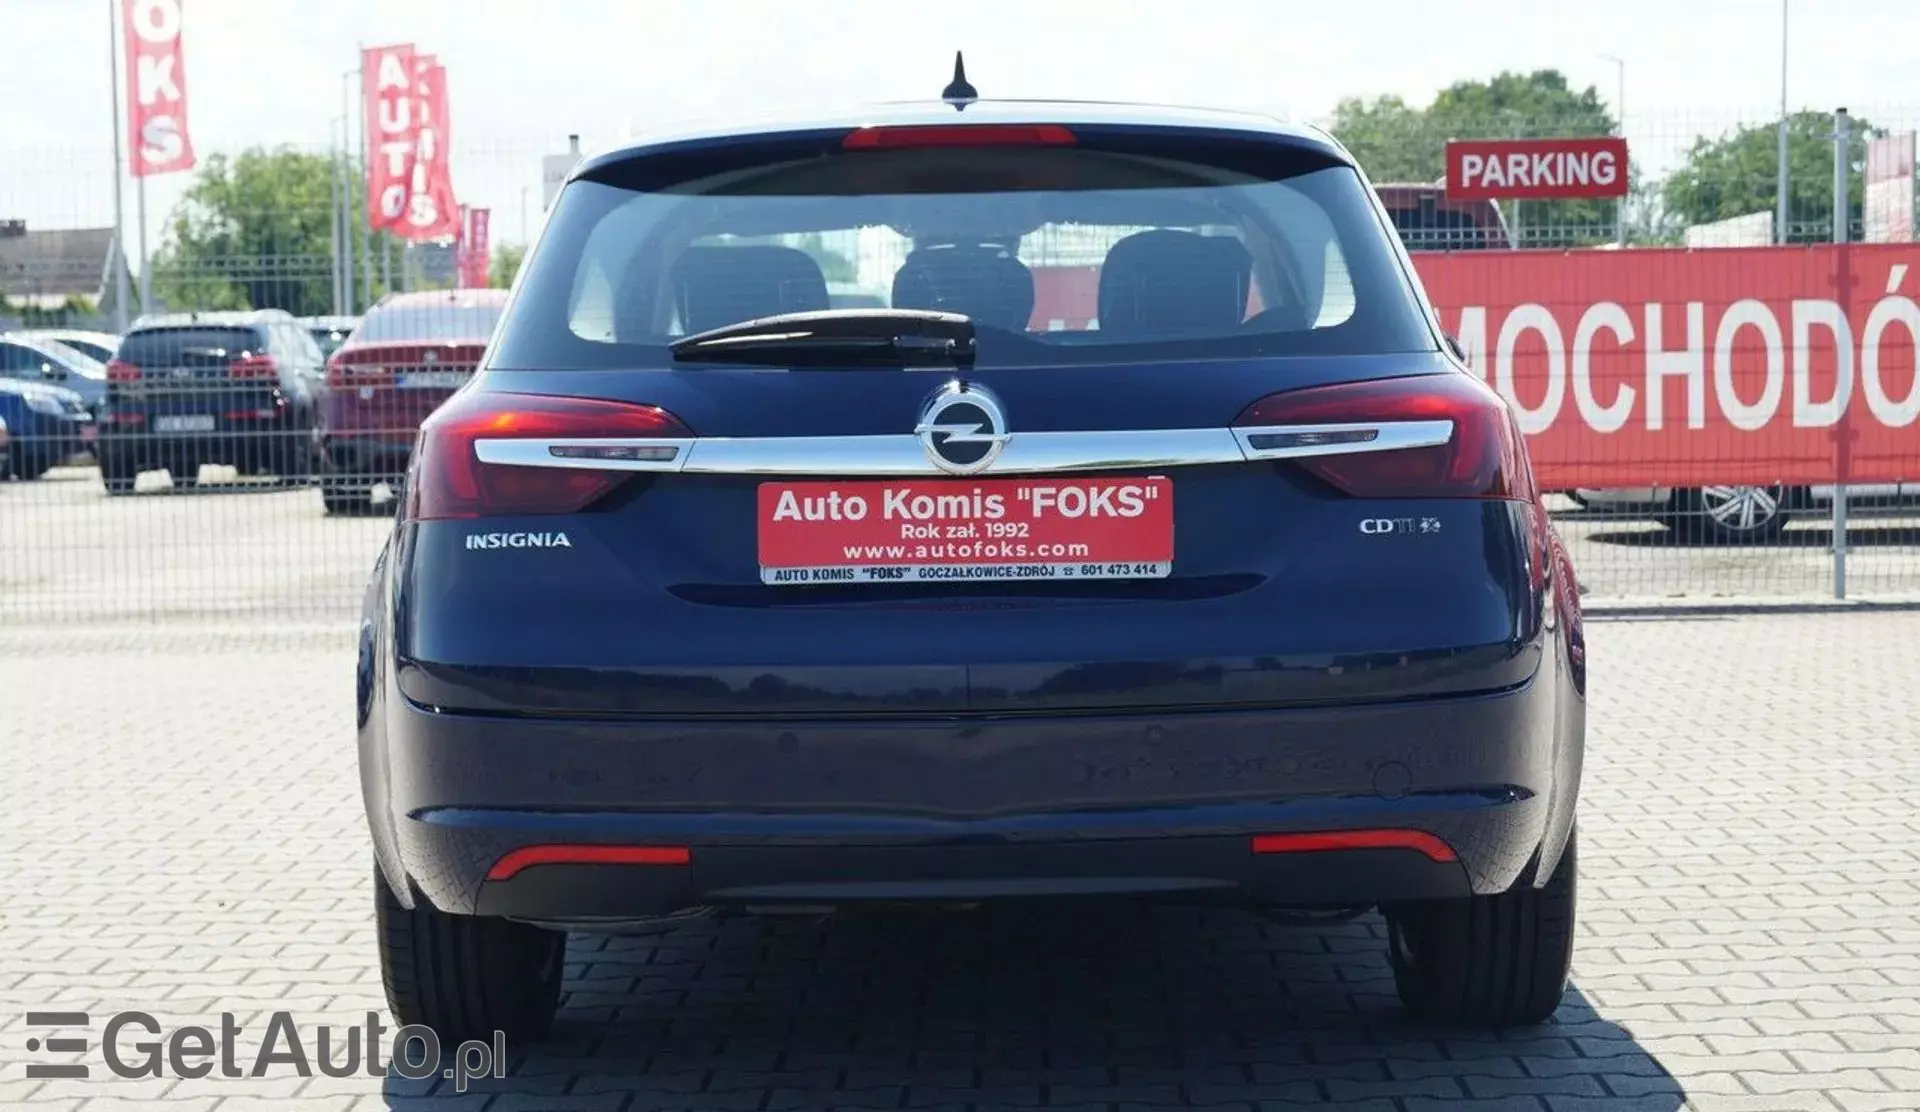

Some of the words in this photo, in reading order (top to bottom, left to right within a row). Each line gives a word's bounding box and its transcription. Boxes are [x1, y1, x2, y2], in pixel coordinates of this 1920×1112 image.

[132, 0, 184, 165] OKS
[378, 53, 412, 221] AUTO
[1461, 151, 1617, 188] PARKING
[773, 490, 868, 521] Auto
[883, 488, 1005, 520] Komis
[1017, 485, 1158, 518] "FOKS"
[901, 523, 940, 540] Rok
[946, 522, 979, 538] zał.
[985, 522, 1030, 538] 1992
[1360, 518, 1415, 534] CDTI
[466, 532, 572, 550] INSIGNIA
[843, 541, 1089, 559] www.autofoks.com
[775, 569, 808, 582] AUTO
[813, 568, 855, 581] KOMIS
[919, 564, 1055, 580] GOCZAŁKOWICE-ZDRÓJ
[1081, 564, 1103, 576] 601
[1107, 564, 1130, 575] 473
[1134, 563, 1157, 575] 414
